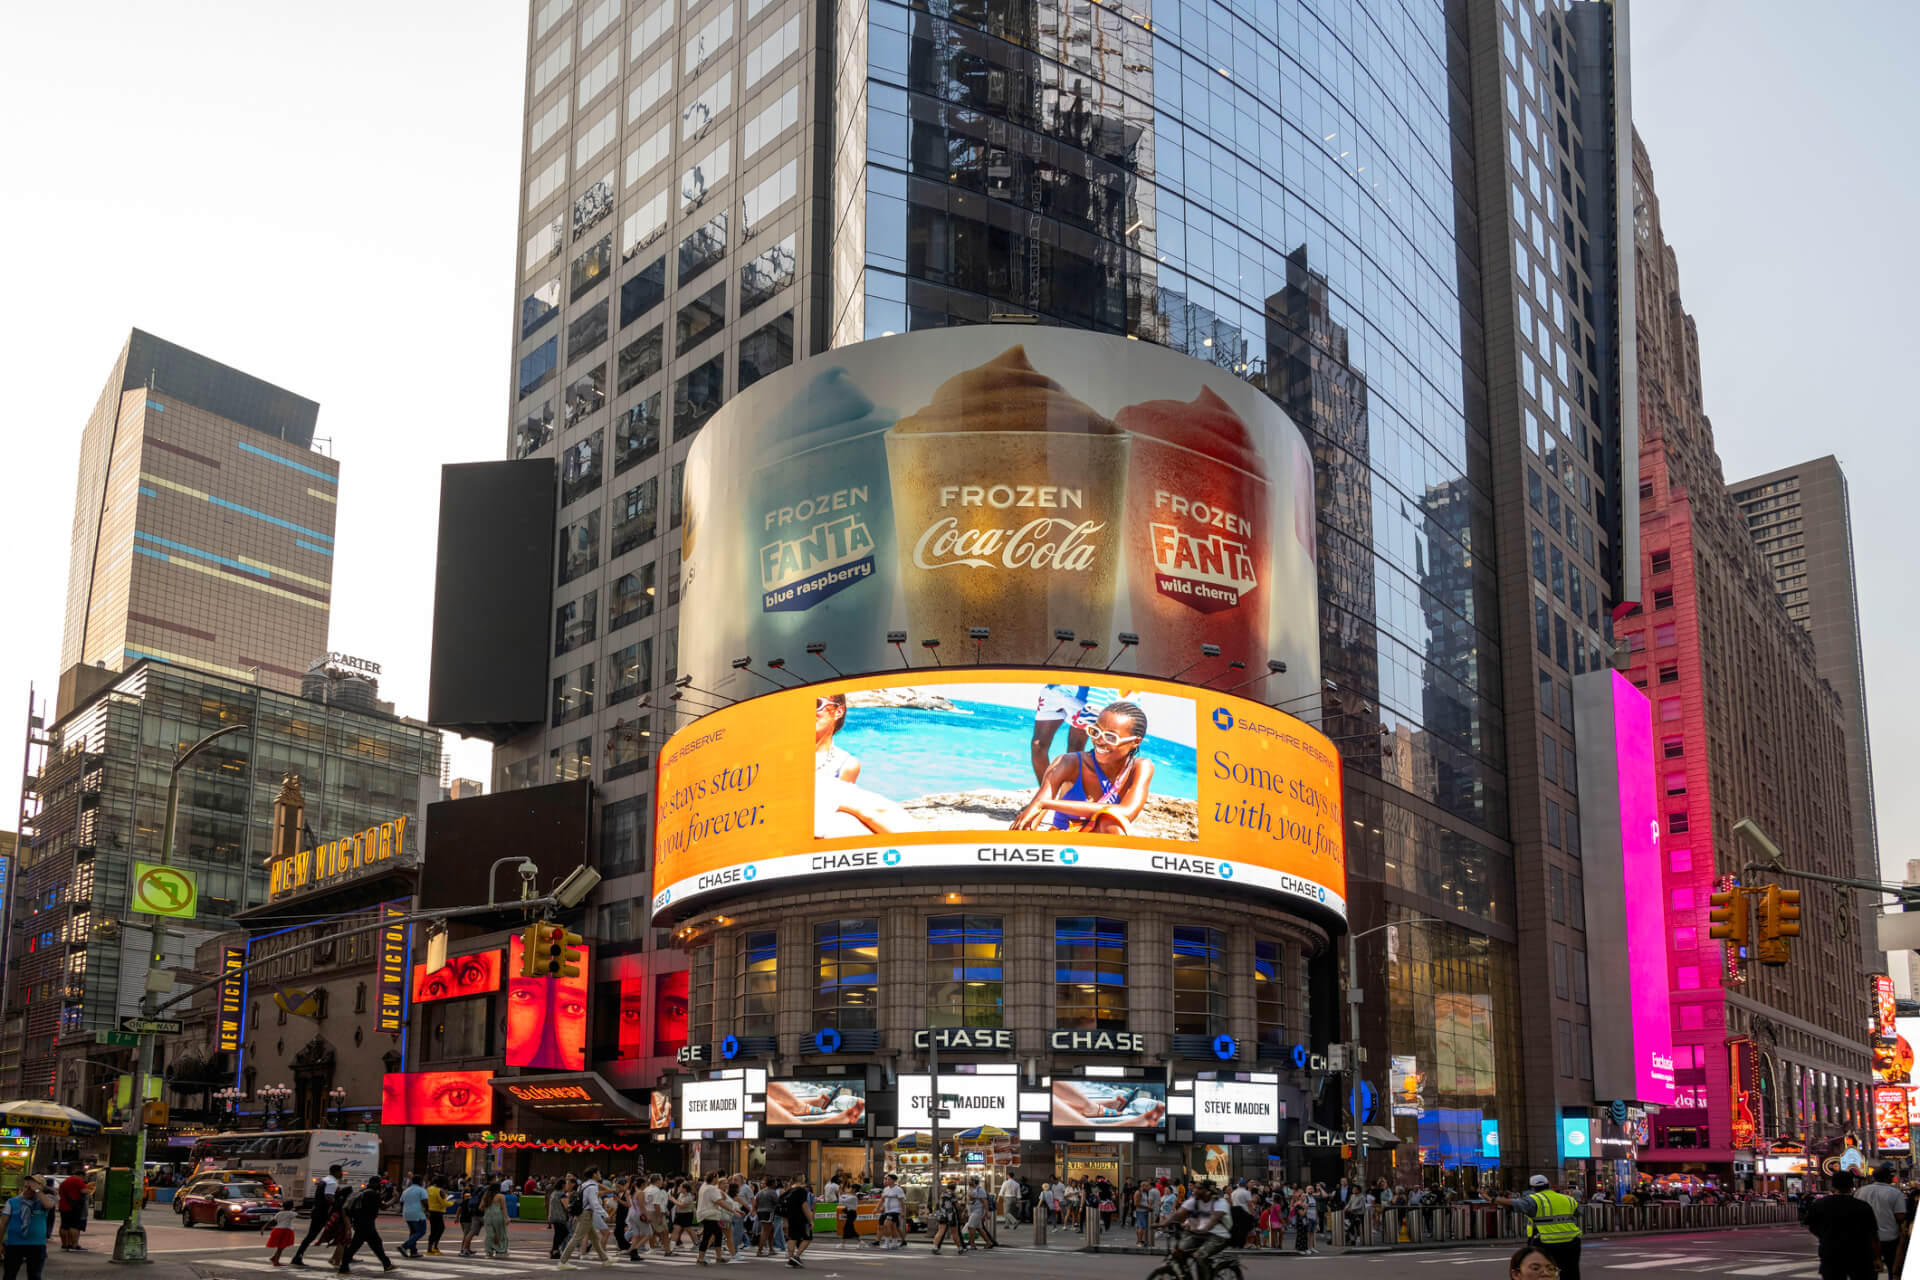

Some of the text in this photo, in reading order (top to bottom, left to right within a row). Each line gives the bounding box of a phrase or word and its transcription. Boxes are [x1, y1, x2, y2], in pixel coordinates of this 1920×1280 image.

[764, 485, 869, 531] FROZEN
[940, 484, 1083, 509] FROZEN
[1155, 489, 1252, 539] FROZEN
[760, 515, 874, 590] FANTA
[912, 516, 1106, 571] Coca-Cola
[1149, 521, 1257, 595] FANTA
[765, 561, 872, 608] blue raspberry
[1160, 579, 1237, 606] wild cherry
[332, 651, 382, 675] CARTER
[1238, 718, 1301, 750] SAPPHIRE
[669, 779, 706, 814] stays
[710, 762, 759, 793] stay
[1213, 749, 1284, 794] Some
[1289, 779, 1329, 818] stays
[681, 804, 764, 853] forever.
[1214, 799, 1272, 833] with
[1272, 816, 1312, 846] you
[270, 815, 407, 895] NEW VICTORY
[812, 852, 878, 870] CHASE
[976, 848, 1055, 862] CHASE
[1151, 855, 1216, 875] CHASE
[698, 868, 741, 889] CHASE
[1280, 876, 1317, 898] CHASE
[381, 993, 401, 1030] NEW
[220, 1020, 239, 1050] NEW
[914, 1029, 1012, 1049] CHASE
[1051, 1030, 1144, 1052] CHASE
[508, 1084, 592, 1101] Subway
[688, 1098, 737, 1113] STEVE MADDEN
[912, 1096, 1005, 1109] STEE MADDEN
[1204, 1100, 1270, 1116] STEVE MADDEN
